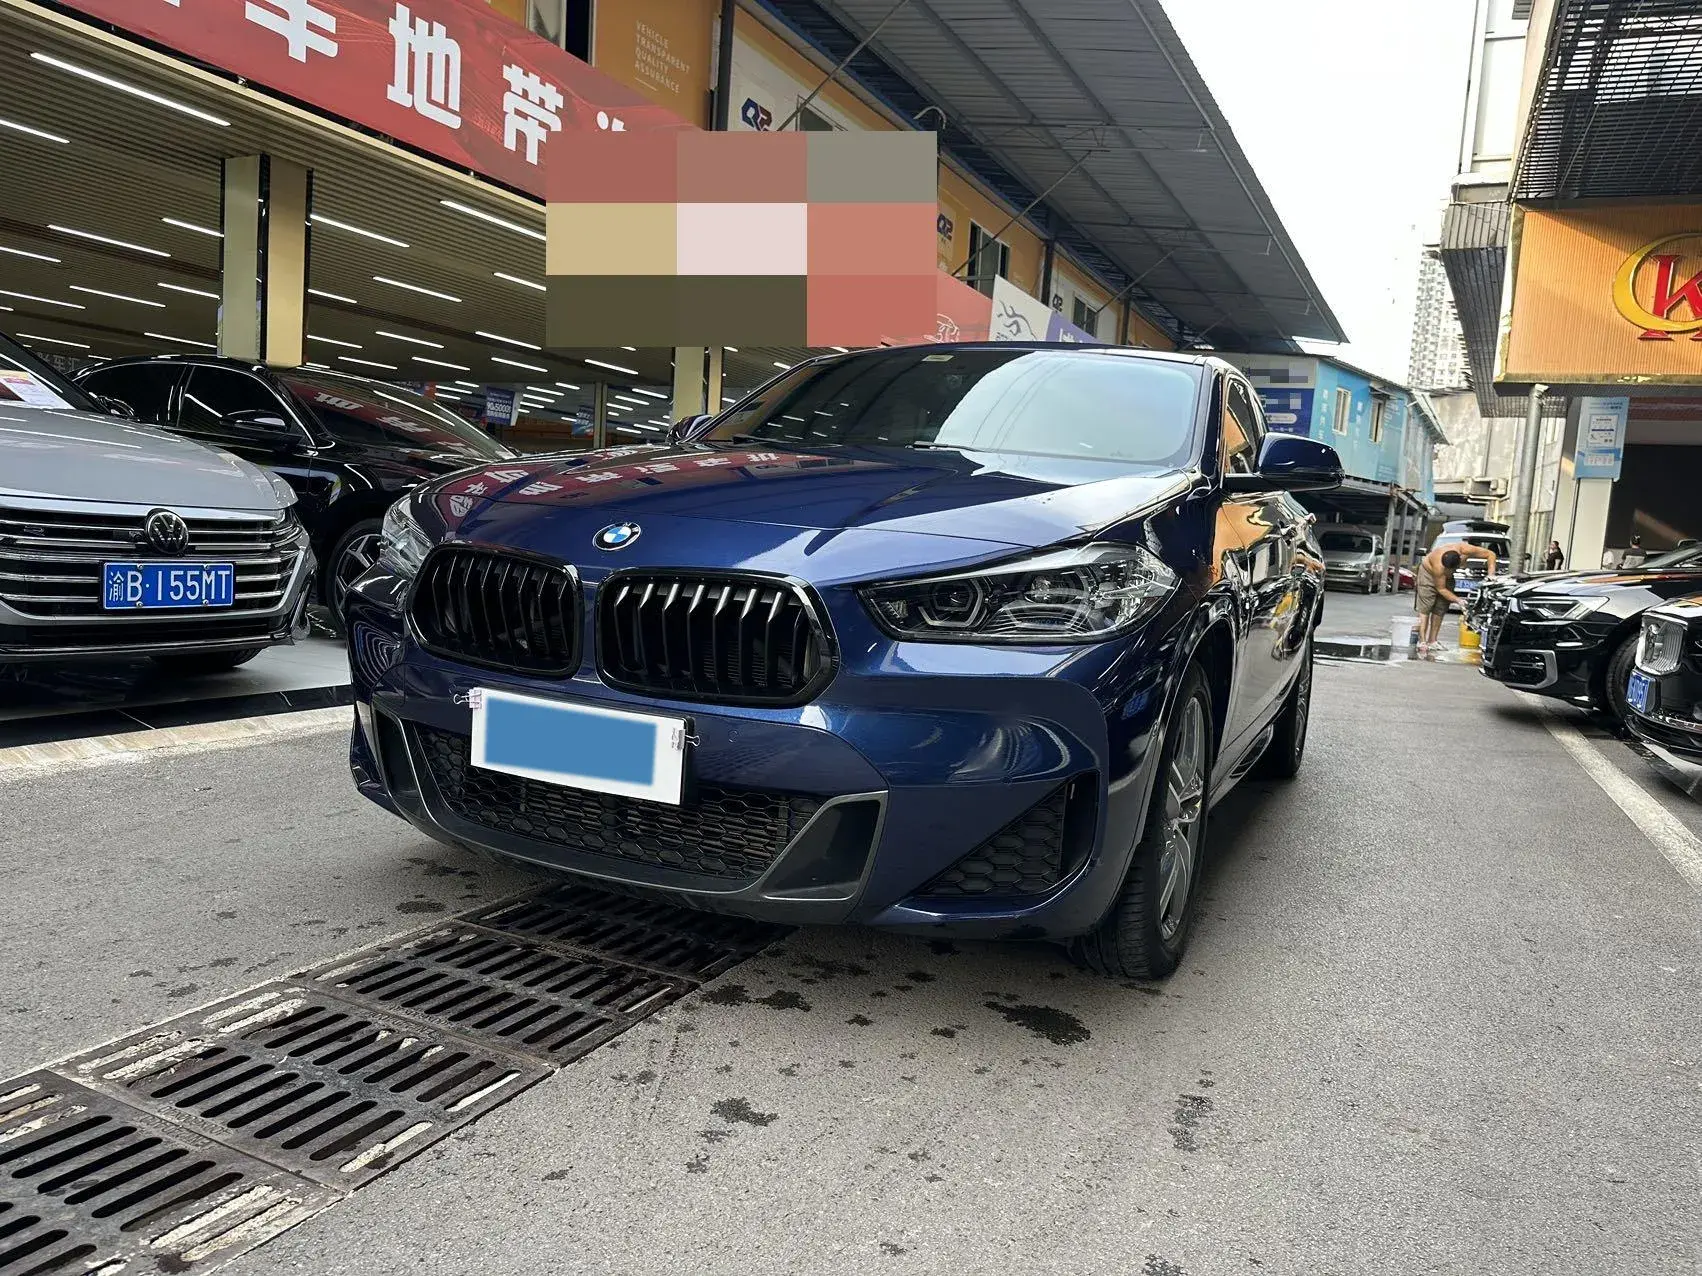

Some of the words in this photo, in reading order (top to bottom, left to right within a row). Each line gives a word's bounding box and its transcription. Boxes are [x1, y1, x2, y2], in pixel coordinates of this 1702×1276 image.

[635, 19, 669, 49] VEHICLE
[635, 32, 691, 74] TRANSPARENT
[635, 47, 669, 74] QUALITY
[634, 60, 680, 94] ASSURANCE
